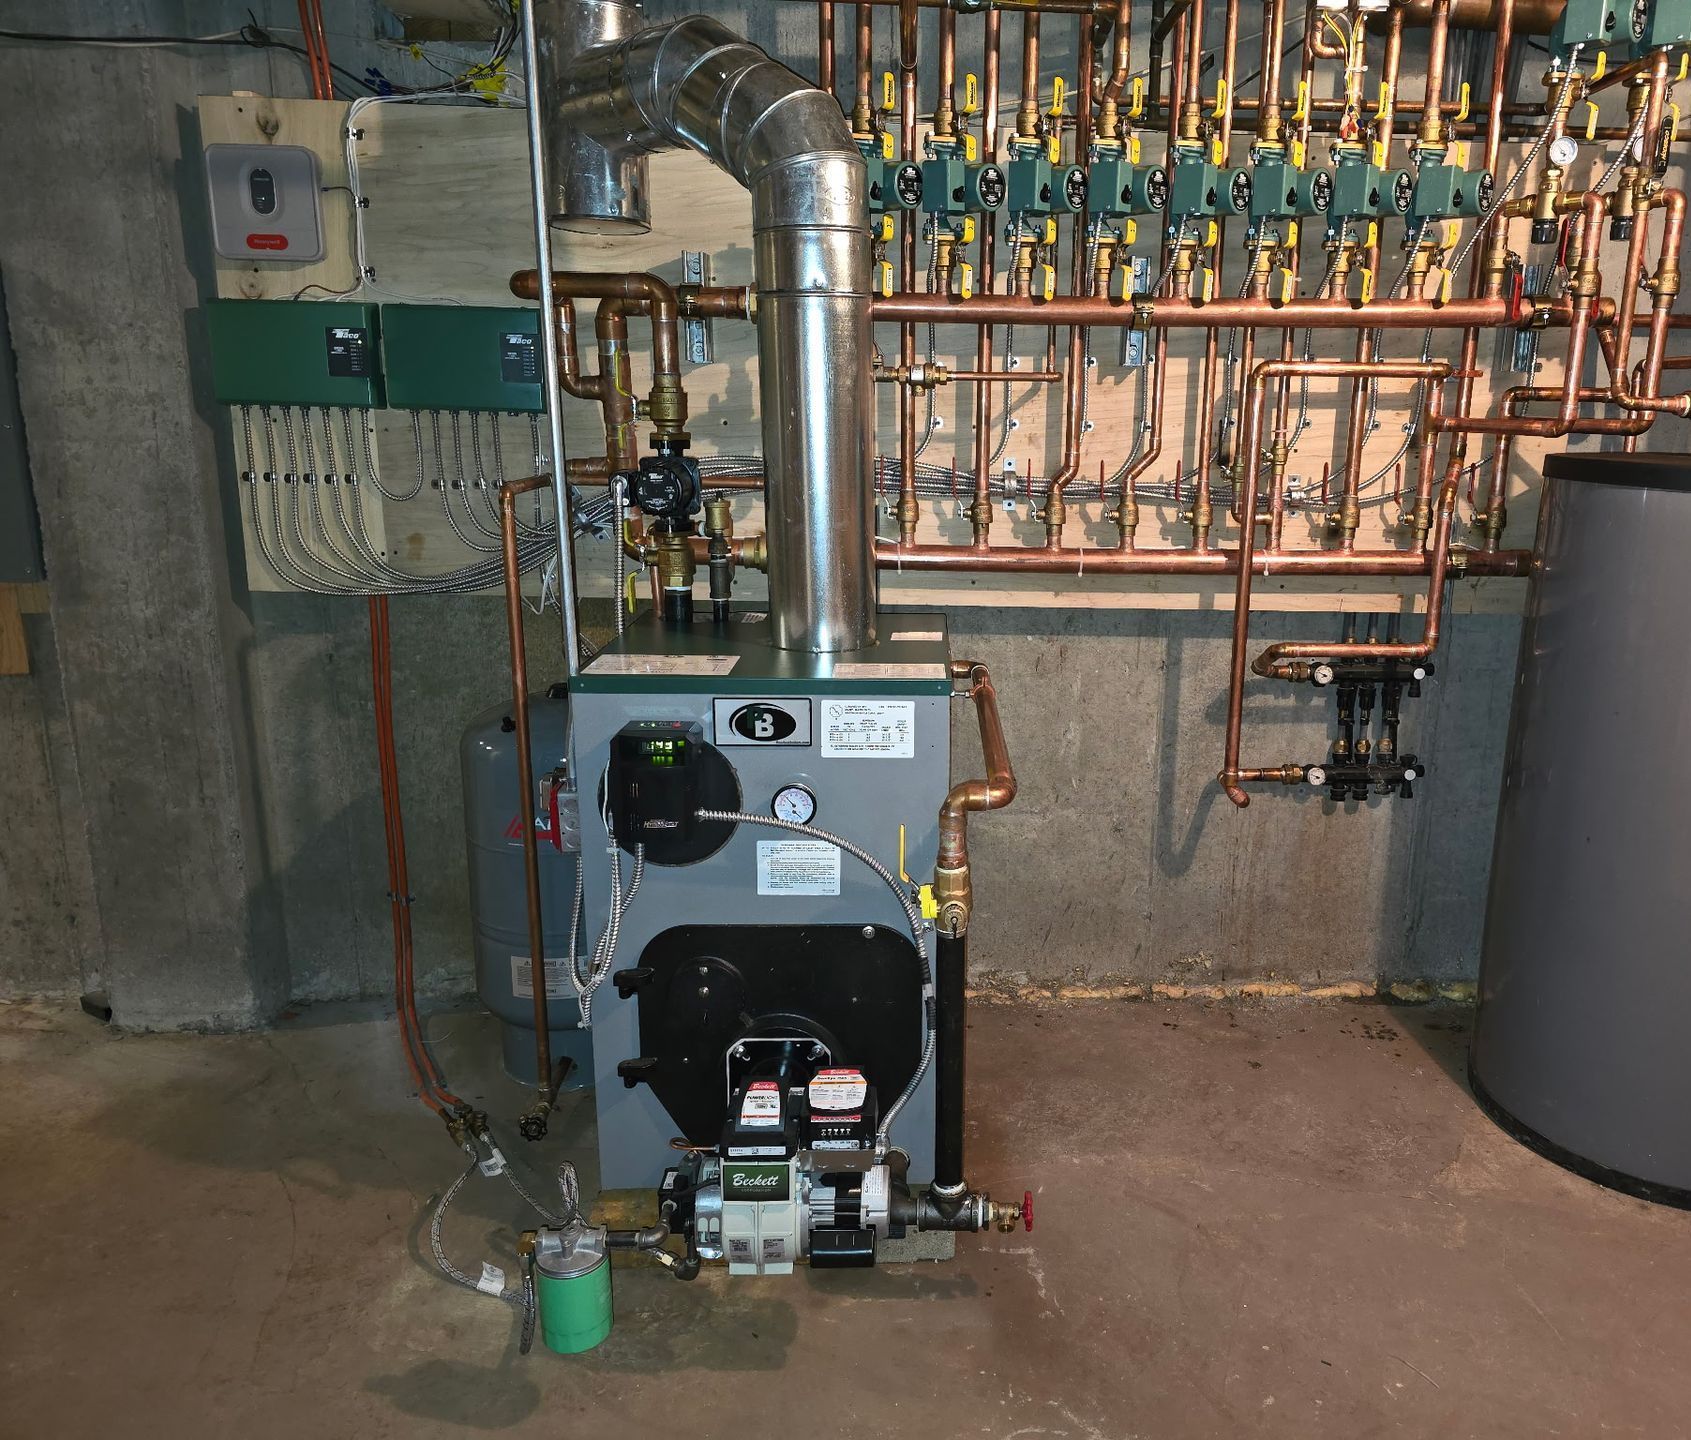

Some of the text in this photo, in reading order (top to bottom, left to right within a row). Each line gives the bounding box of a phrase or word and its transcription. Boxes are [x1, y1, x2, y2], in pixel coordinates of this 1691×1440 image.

[331, 328, 361, 339] Taco
[505, 334, 533, 344] Taco
[732, 1173, 779, 1187] Beckett
